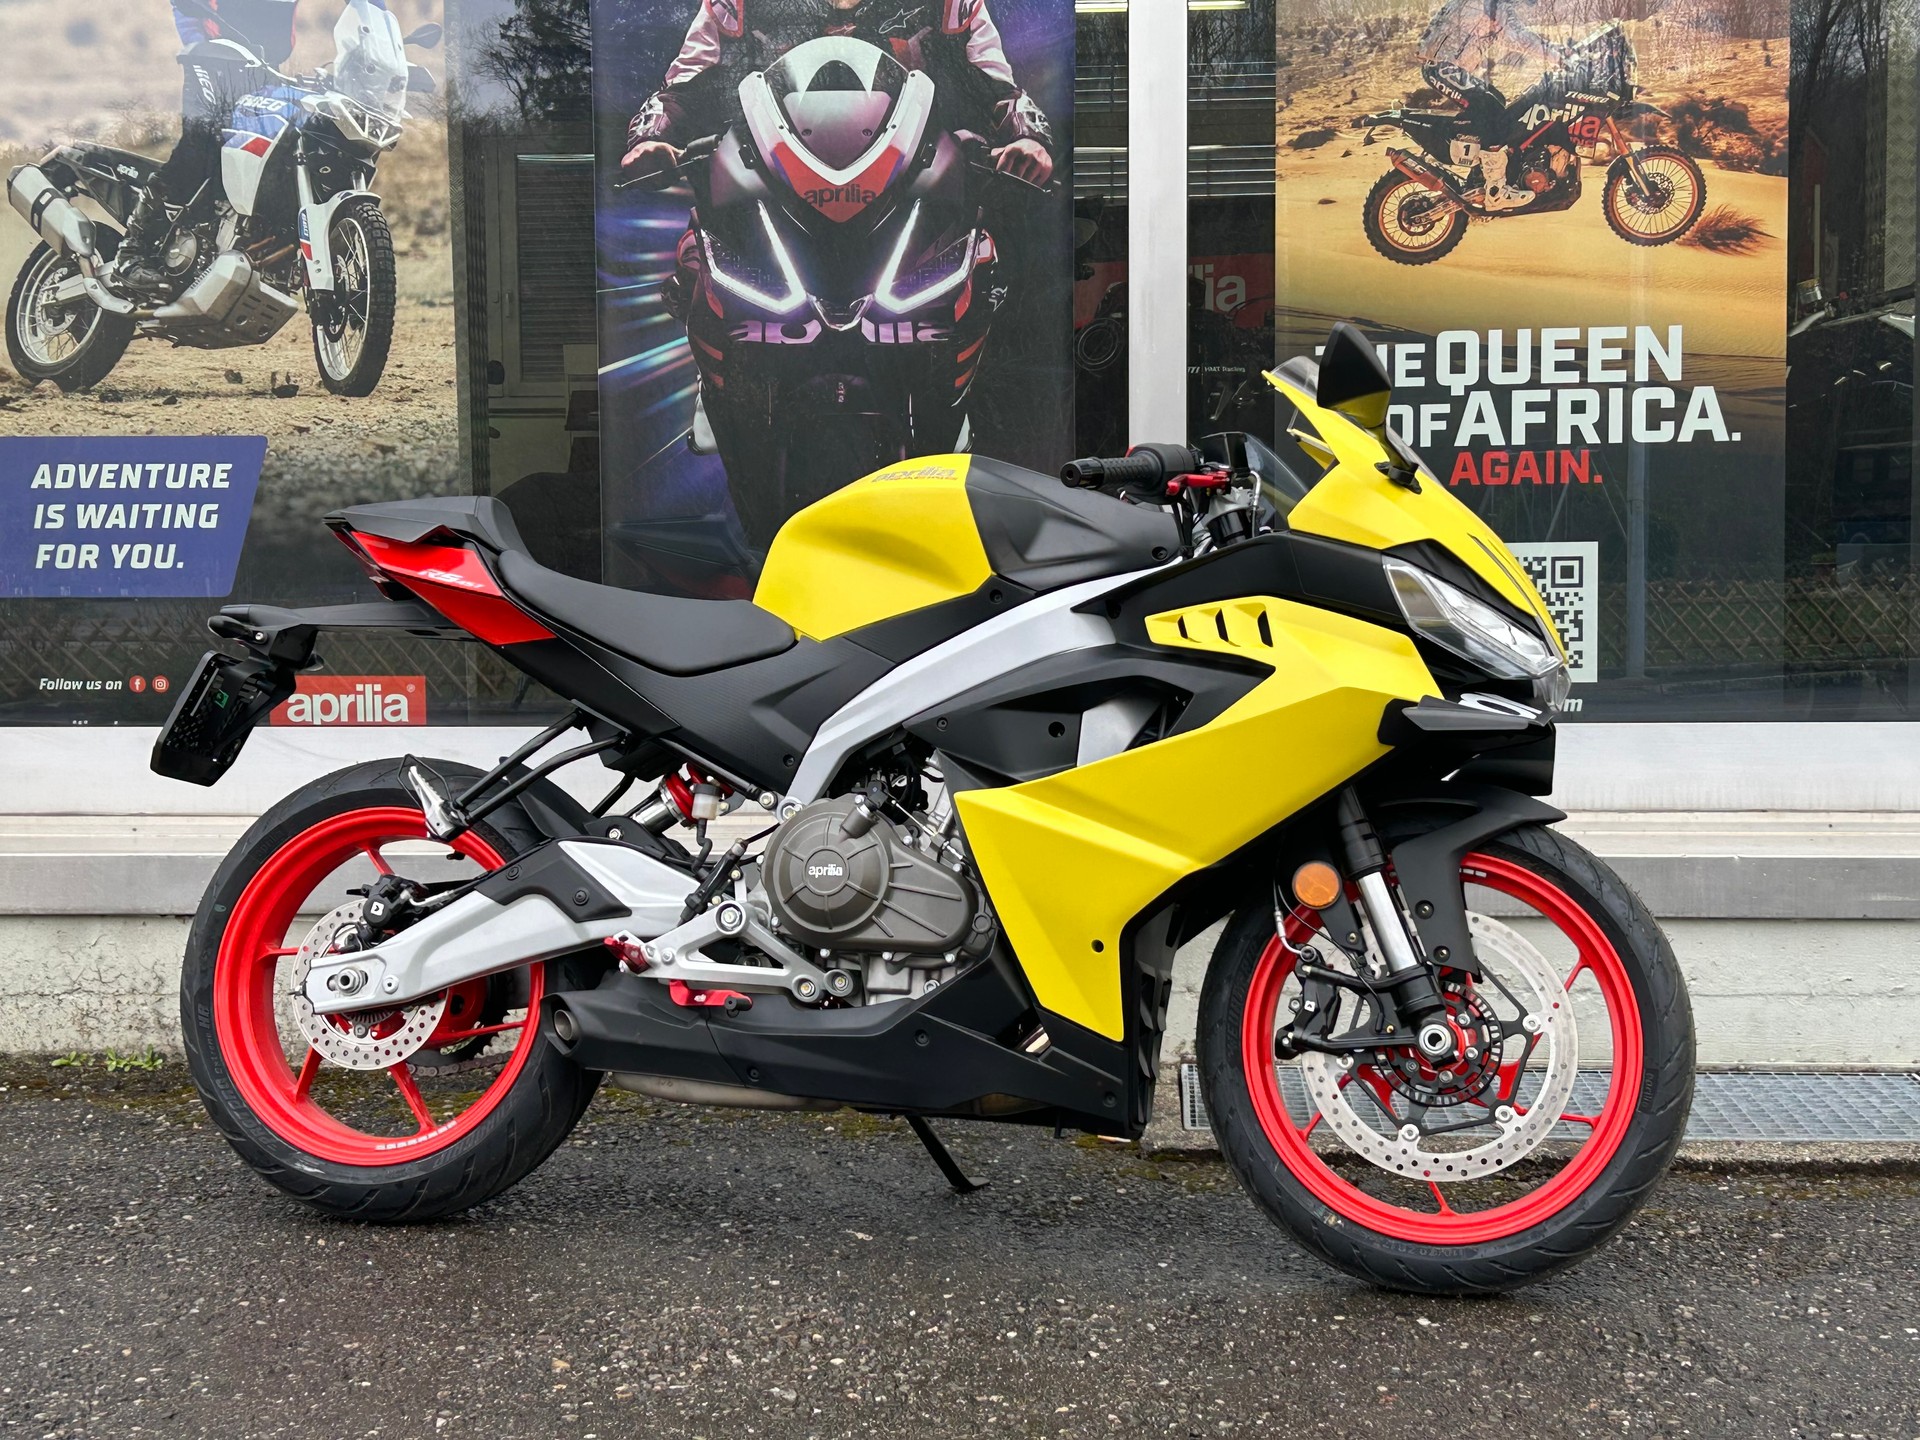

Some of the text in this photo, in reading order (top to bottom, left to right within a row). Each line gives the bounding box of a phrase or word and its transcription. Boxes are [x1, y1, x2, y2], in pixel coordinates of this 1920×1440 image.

[803, 184, 877, 208] aprilia
[1436, 324, 1683, 396] QUEEN
[1453, 385, 1742, 447] AFRICA.
[30, 463, 233, 489] ADVENTURE
[1449, 449, 1603, 486] AGAIN.
[33, 503, 219, 529] IS WAITING
[35, 543, 185, 570] FOR YOU.
[39, 678, 83, 690] Follow
[86, 680, 102, 690] us
[105, 680, 122, 690] on
[286, 683, 409, 725] aprilia
[808, 863, 843, 878] aprilia
